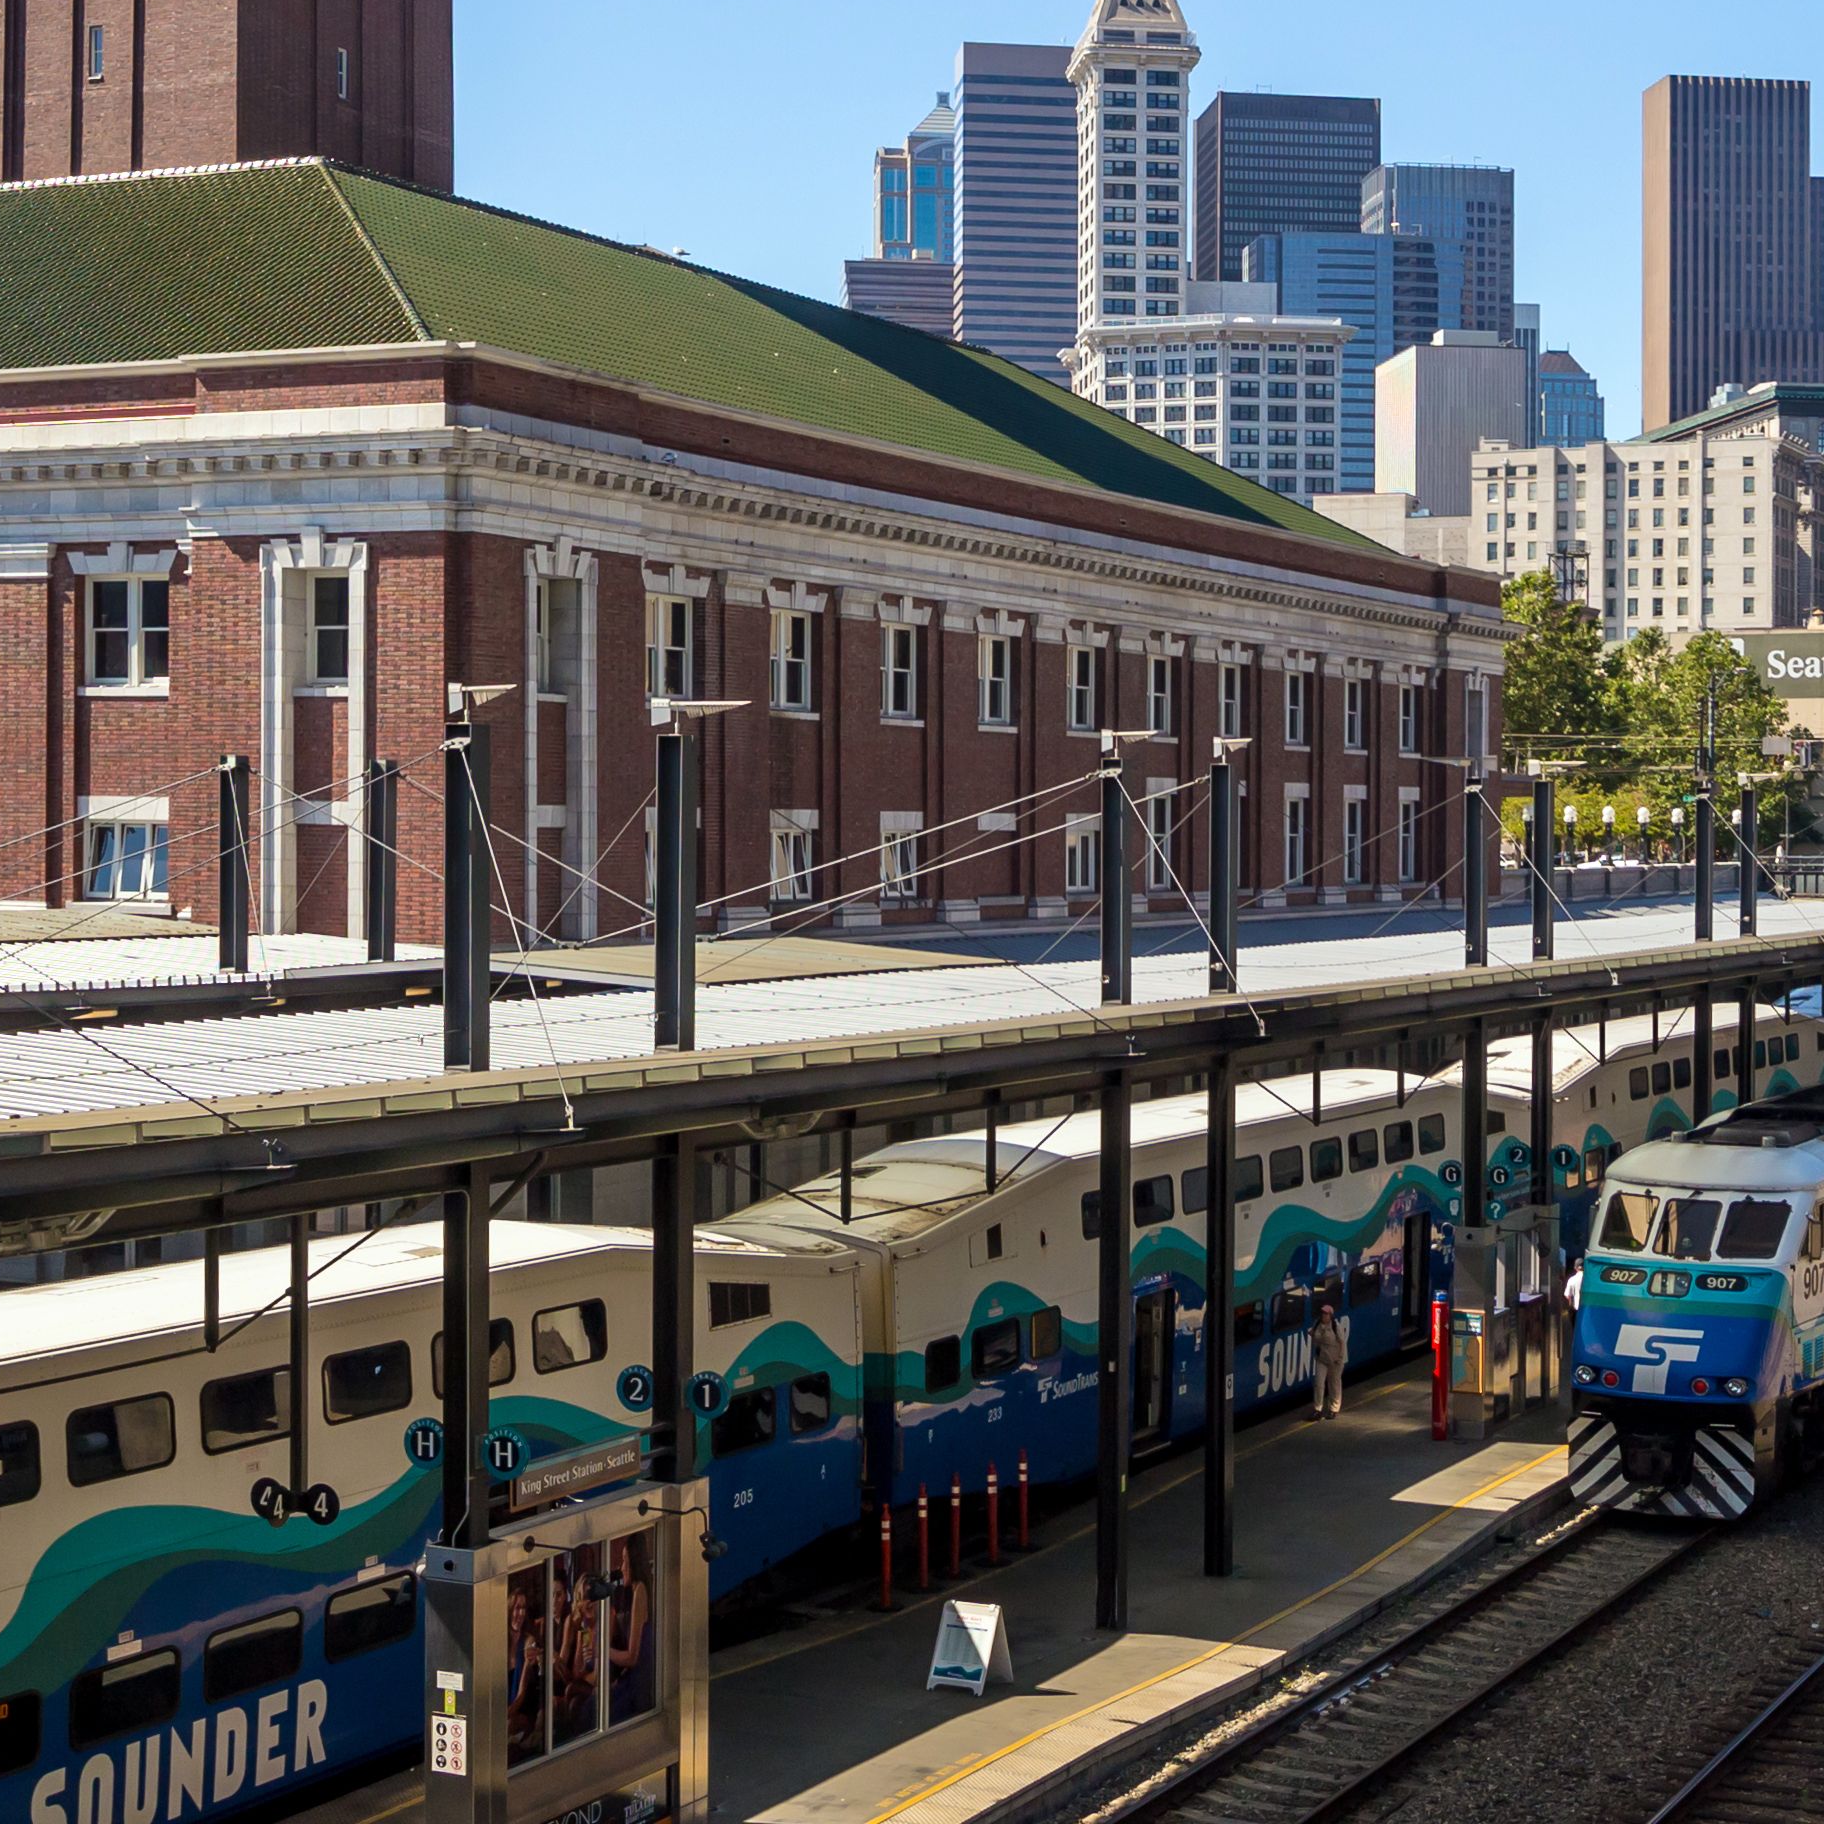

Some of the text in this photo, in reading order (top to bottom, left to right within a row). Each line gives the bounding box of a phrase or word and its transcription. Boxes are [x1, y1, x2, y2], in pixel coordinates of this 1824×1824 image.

[1514, 1149, 1523, 1163] 2
[1560, 1151, 1566, 1165] 1
[1445, 1166, 1457, 1182] G
[1493, 1168, 1505, 1184] G
[1610, 1270, 1639, 1282] 907
[1707, 1278, 1737, 1289] 907
[1257, 1314, 1350, 1398] SOUNR
[629, 1377, 643, 1401] 2
[702, 1384, 710, 1408] 1
[988, 1406, 1003, 1423] 233
[416, 1430, 434, 1458] H
[493, 1441, 513, 1468] H
[521, 1449, 636, 1495] King Street Station Seattle
[273, 1494, 285, 1519] 4
[314, 1492, 329, 1518] 4
[733, 1488, 754, 1508] 205
[31, 1679, 327, 1824] SOUNDER
